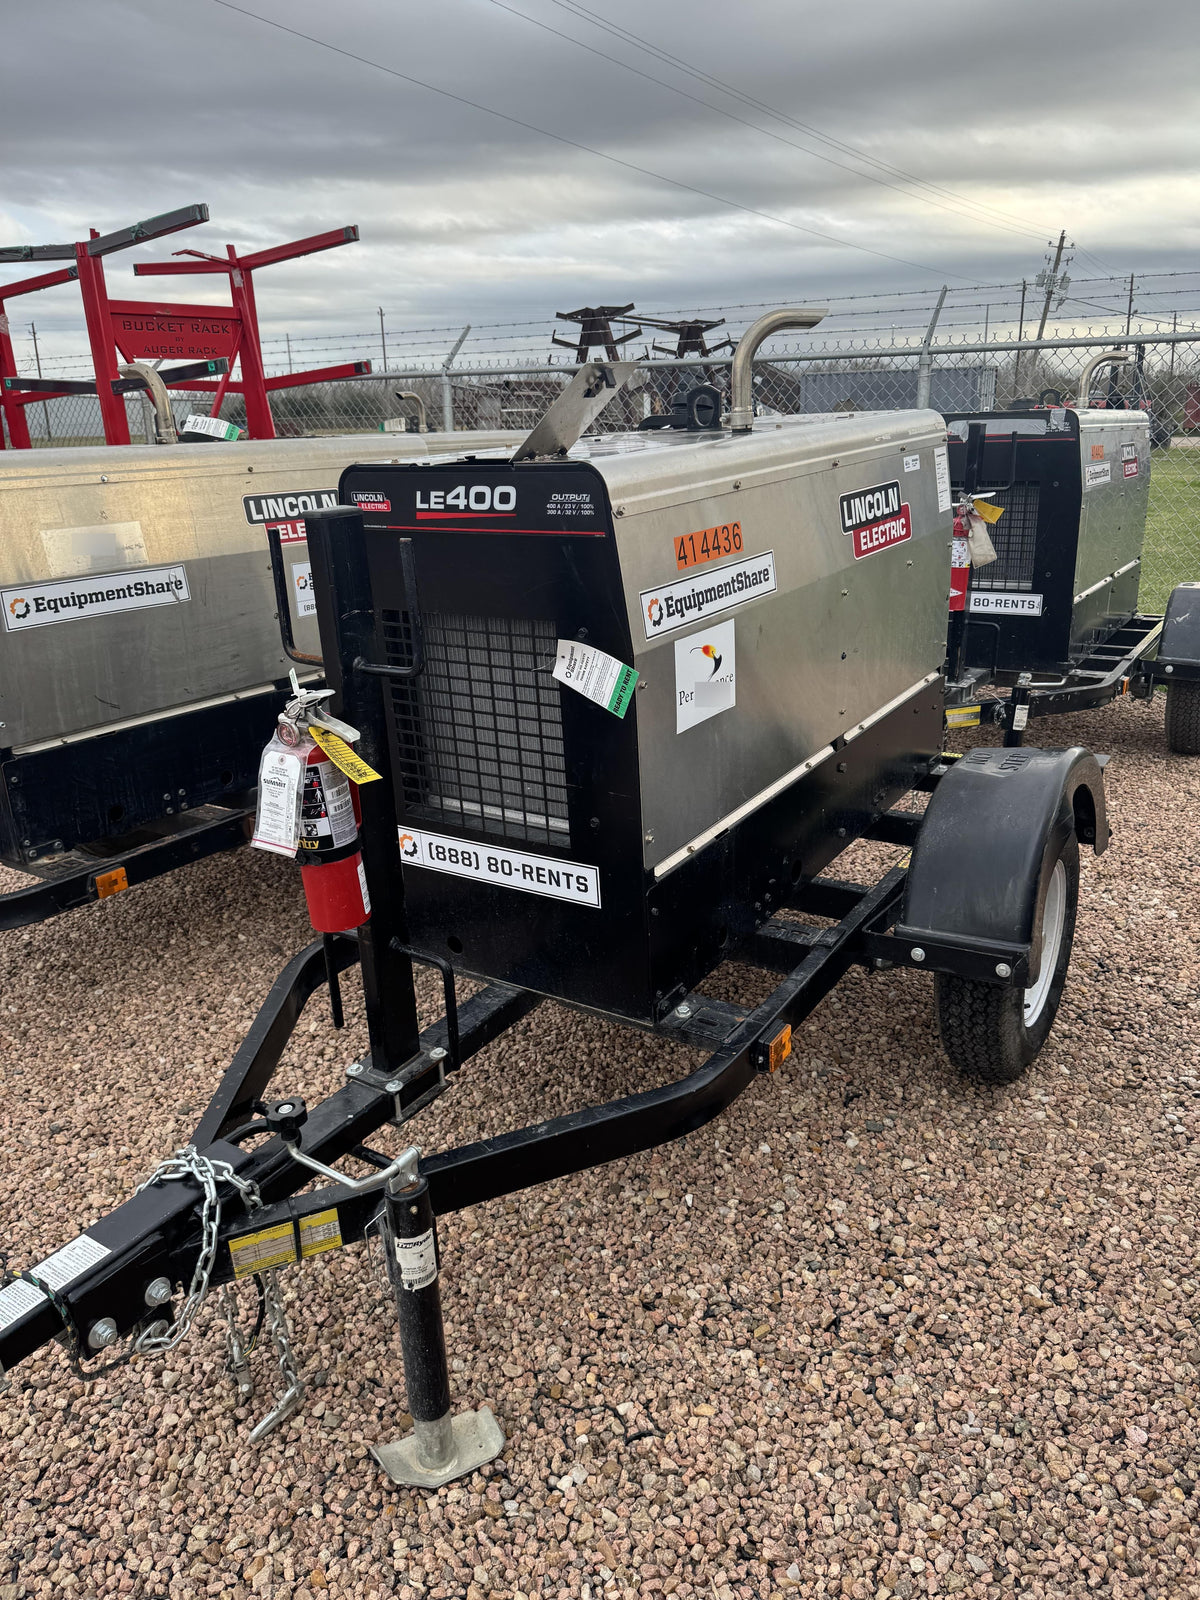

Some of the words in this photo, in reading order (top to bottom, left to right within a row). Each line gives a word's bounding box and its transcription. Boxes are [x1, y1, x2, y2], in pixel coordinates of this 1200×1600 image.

[123, 320, 184, 332] BUCKET
[191, 323, 230, 334] RACK
[143, 345, 184, 354] AUGER
[188, 346, 218, 355] RACK
[353, 493, 383, 502] LINCOLN
[416, 485, 517, 511] LE400
[551, 493, 588, 501] OUTPUT
[843, 487, 899, 527] LINCOLN
[860, 517, 907, 551] ELECTRIC
[677, 522, 742, 566] 414436
[33, 578, 184, 613] EquipmentShare
[665, 566, 770, 618] EquipmentShare
[973, 597, 1035, 610] 80-RENTS
[612, 695, 624, 714] READY
[620, 685, 627, 694] TO
[624, 668, 633, 685] RENT
[966, 752, 992, 765] NO
[998, 753, 1029, 771] STEP
[263, 778, 287, 788] SUMMIT
[298, 838, 319, 850] ntry
[428, 841, 480, 870] (888)
[488, 856, 589, 894] 80-RENTS
